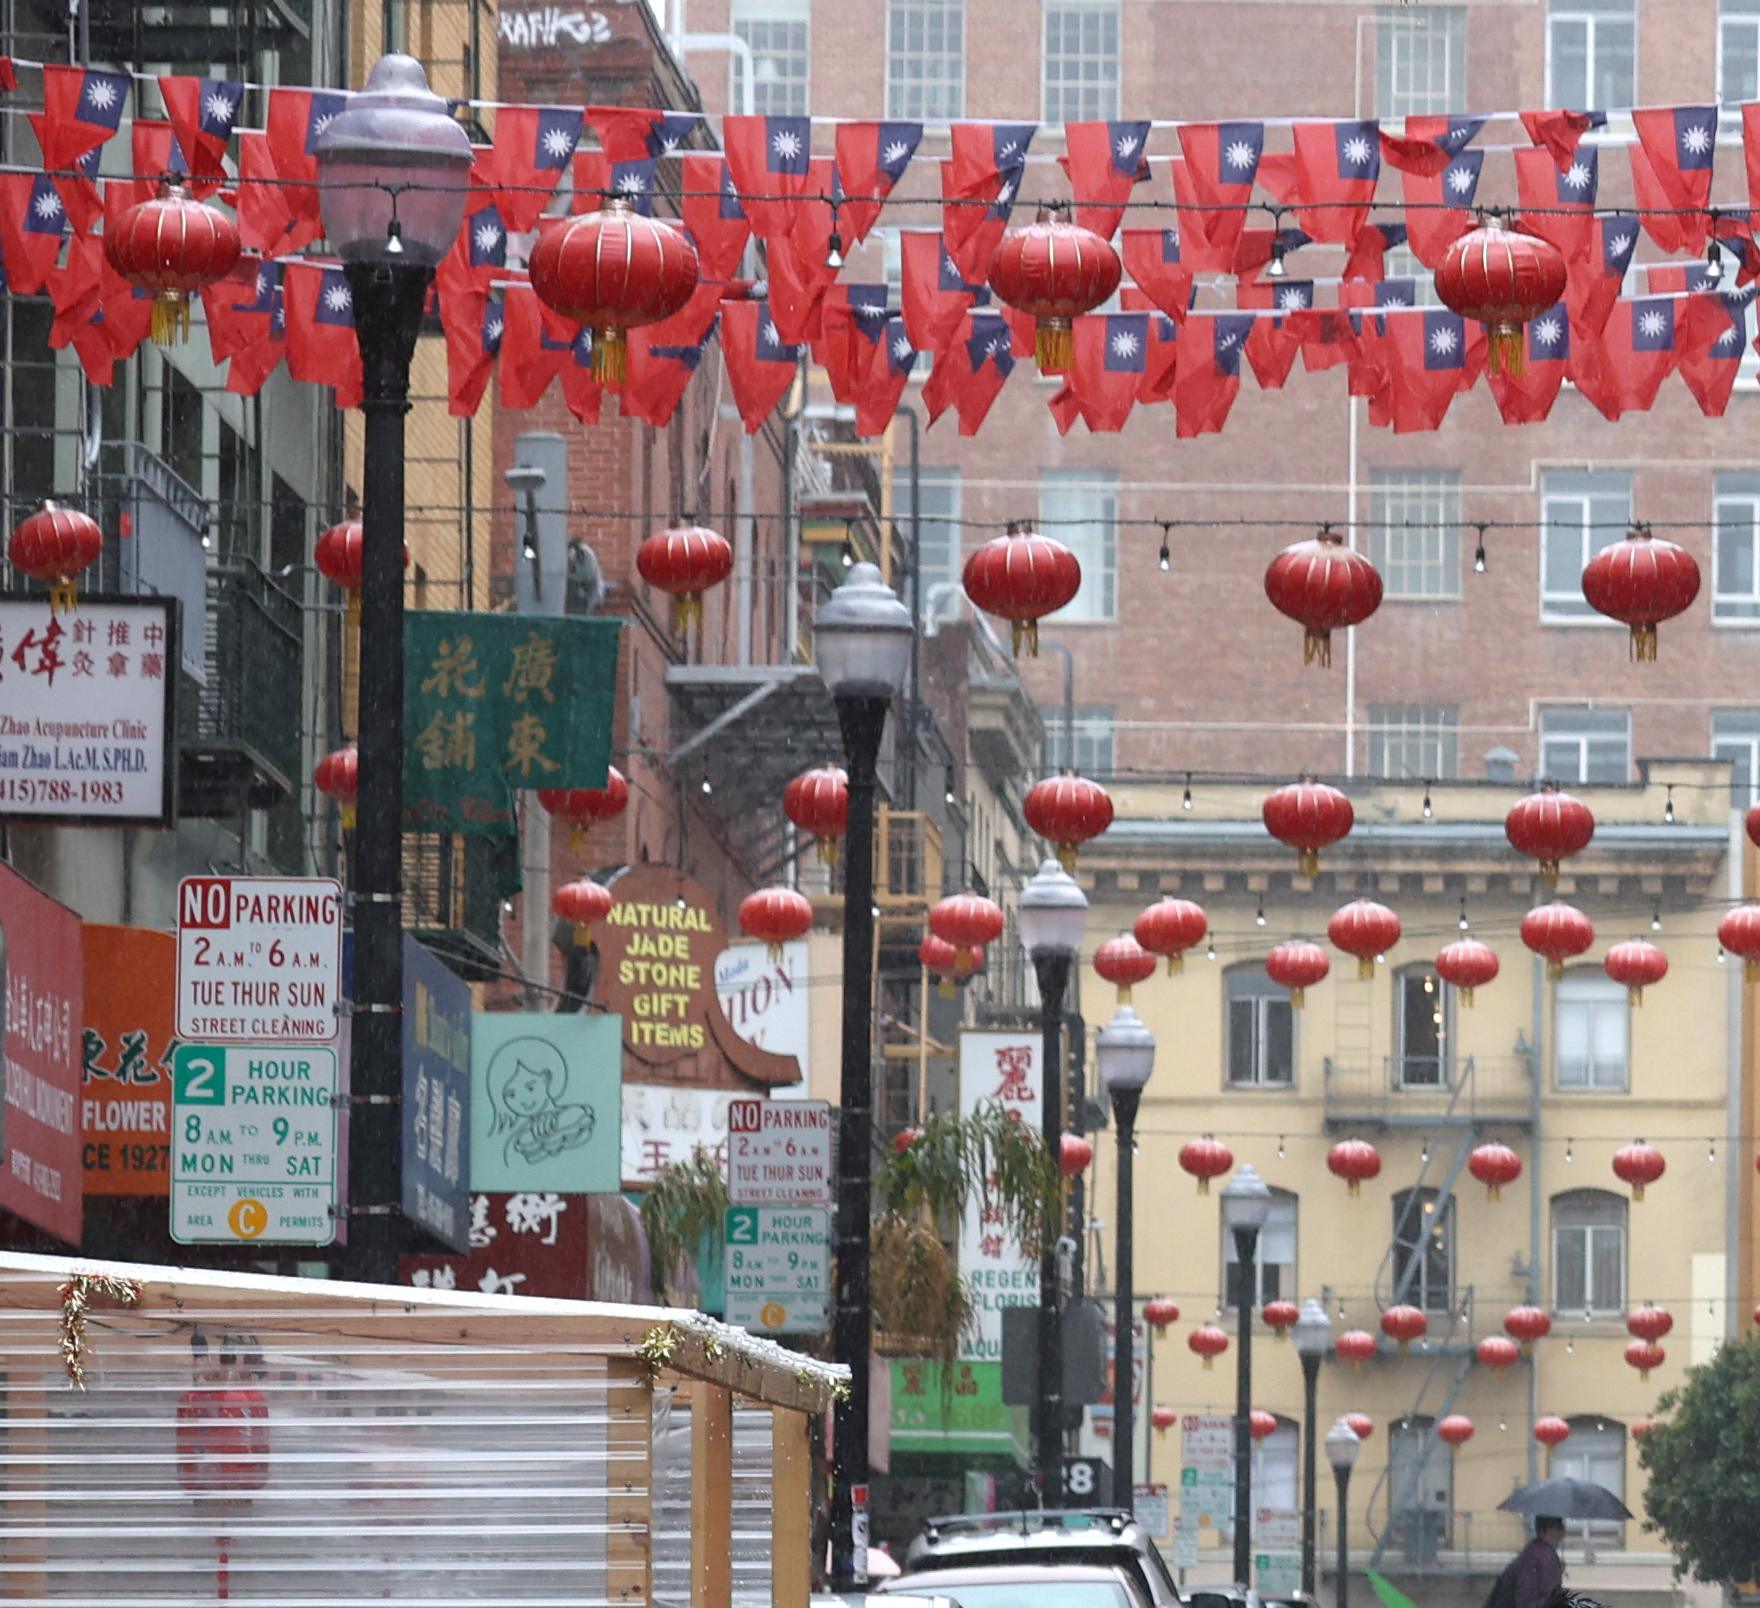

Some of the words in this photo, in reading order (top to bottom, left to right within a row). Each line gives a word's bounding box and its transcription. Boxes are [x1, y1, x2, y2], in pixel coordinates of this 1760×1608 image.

[33, 717, 109, 743] Acupuncture
[112, 718, 147, 741] Clinic
[22, 744, 51, 770] Zhao
[184, 883, 226, 925] NO
[236, 894, 335, 925] PARKING
[607, 902, 712, 933] NATURAL
[194, 937, 211, 966] 2
[216, 950, 252, 968] A.M.
[250, 942, 262, 954] TO
[268, 938, 285, 967] 6
[292, 952, 328, 969] A.M.
[626, 932, 690, 961] JADE
[618, 960, 702, 990] STONE
[191, 981, 225, 1006] TUE
[231, 981, 281, 1007] THUR
[287, 982, 325, 1008] SUN
[633, 992, 690, 1018] GIFT
[191, 1017, 246, 1034] STREET
[251, 1018, 325, 1036] CLEANING
[631, 1021, 705, 1048] ITEMS
[184, 1058, 215, 1098] 2
[248, 1060, 310, 1081] HOUR
[231, 1085, 329, 1107] PARKING
[82, 1100, 166, 1133] FLOWER
[729, 1103, 760, 1132] NO
[764, 1109, 828, 1130] PARKING
[185, 1114, 201, 1144] 8
[206, 1129, 233, 1145] A.M.
[239, 1124, 259, 1138] TO
[272, 1117, 290, 1147] 9
[294, 1131, 322, 1147] P.M.
[119, 1144, 174, 1172] 1927
[738, 1137, 749, 1157] 2
[785, 1138, 797, 1157] 6
[181, 1153, 234, 1175] MON
[243, 1153, 270, 1166] THRU
[286, 1156, 322, 1176] SAT
[737, 1165, 758, 1182] TUE
[763, 1165, 794, 1182] THUR
[798, 1165, 823, 1183] SUN
[187, 1185, 226, 1198] EXCEPT
[236, 1186, 284, 1199] VEHICLES
[293, 1187, 319, 1199] WITH
[186, 1215, 213, 1227] AREA
[238, 1204, 256, 1235] C
[279, 1216, 324, 1229] PERMITS
[732, 1215, 752, 1241] 2
[772, 1215, 812, 1228] HOUR
[762, 1232, 825, 1245] PARKING
[732, 1251, 743, 1270] 8
[788, 1251, 799, 1271] 9
[731, 1275, 764, 1288] MON
[796, 1276, 820, 1289] SAT
